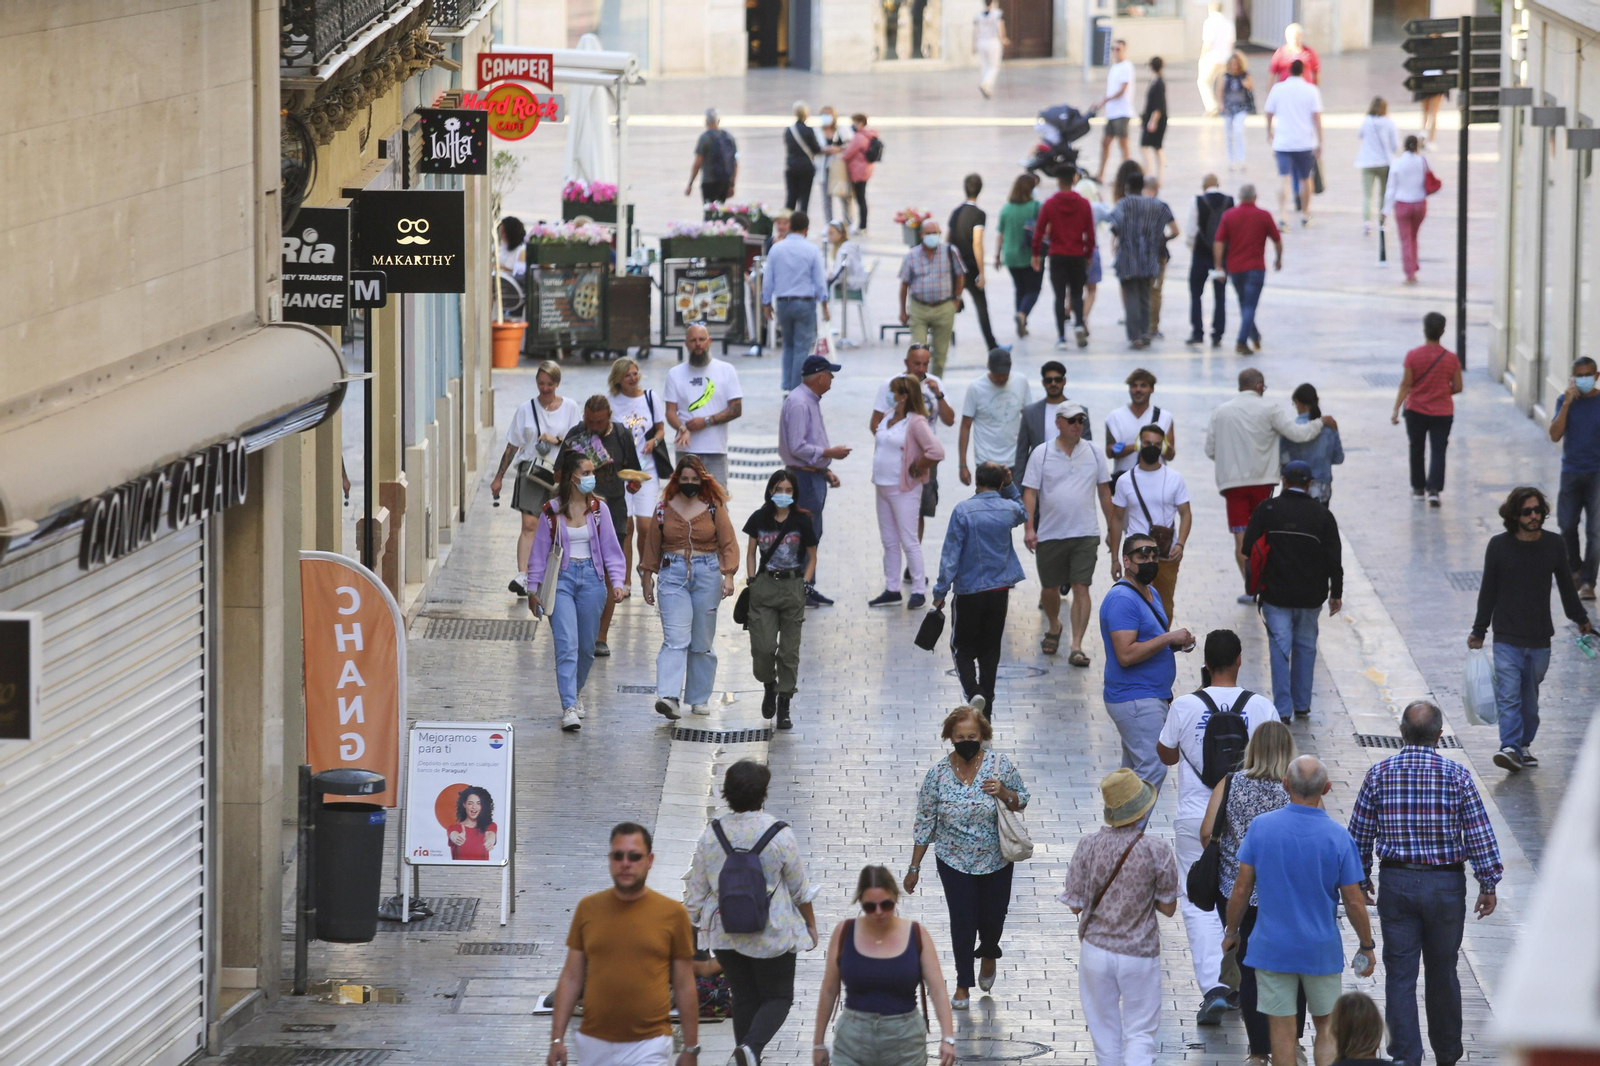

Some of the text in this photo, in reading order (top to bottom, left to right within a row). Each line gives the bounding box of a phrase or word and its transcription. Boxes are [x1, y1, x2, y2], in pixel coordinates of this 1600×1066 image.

[481, 57, 550, 83] CAMPER
[462, 92, 559, 121] Hard Rock
[496, 121, 524, 132] CAFE
[281, 227, 336, 264] Ria
[372, 254, 455, 266] MAKARTHY
[298, 274, 344, 282] TRANSFER
[350, 279, 380, 301] M
[282, 292, 345, 309] HANGE
[168, 436, 248, 531] GELATO
[418, 732, 477, 744] Mejoramos
[418, 744, 452, 755] para ti
[476, 760, 499, 768] cualquier
[413, 846, 429, 857] ria
